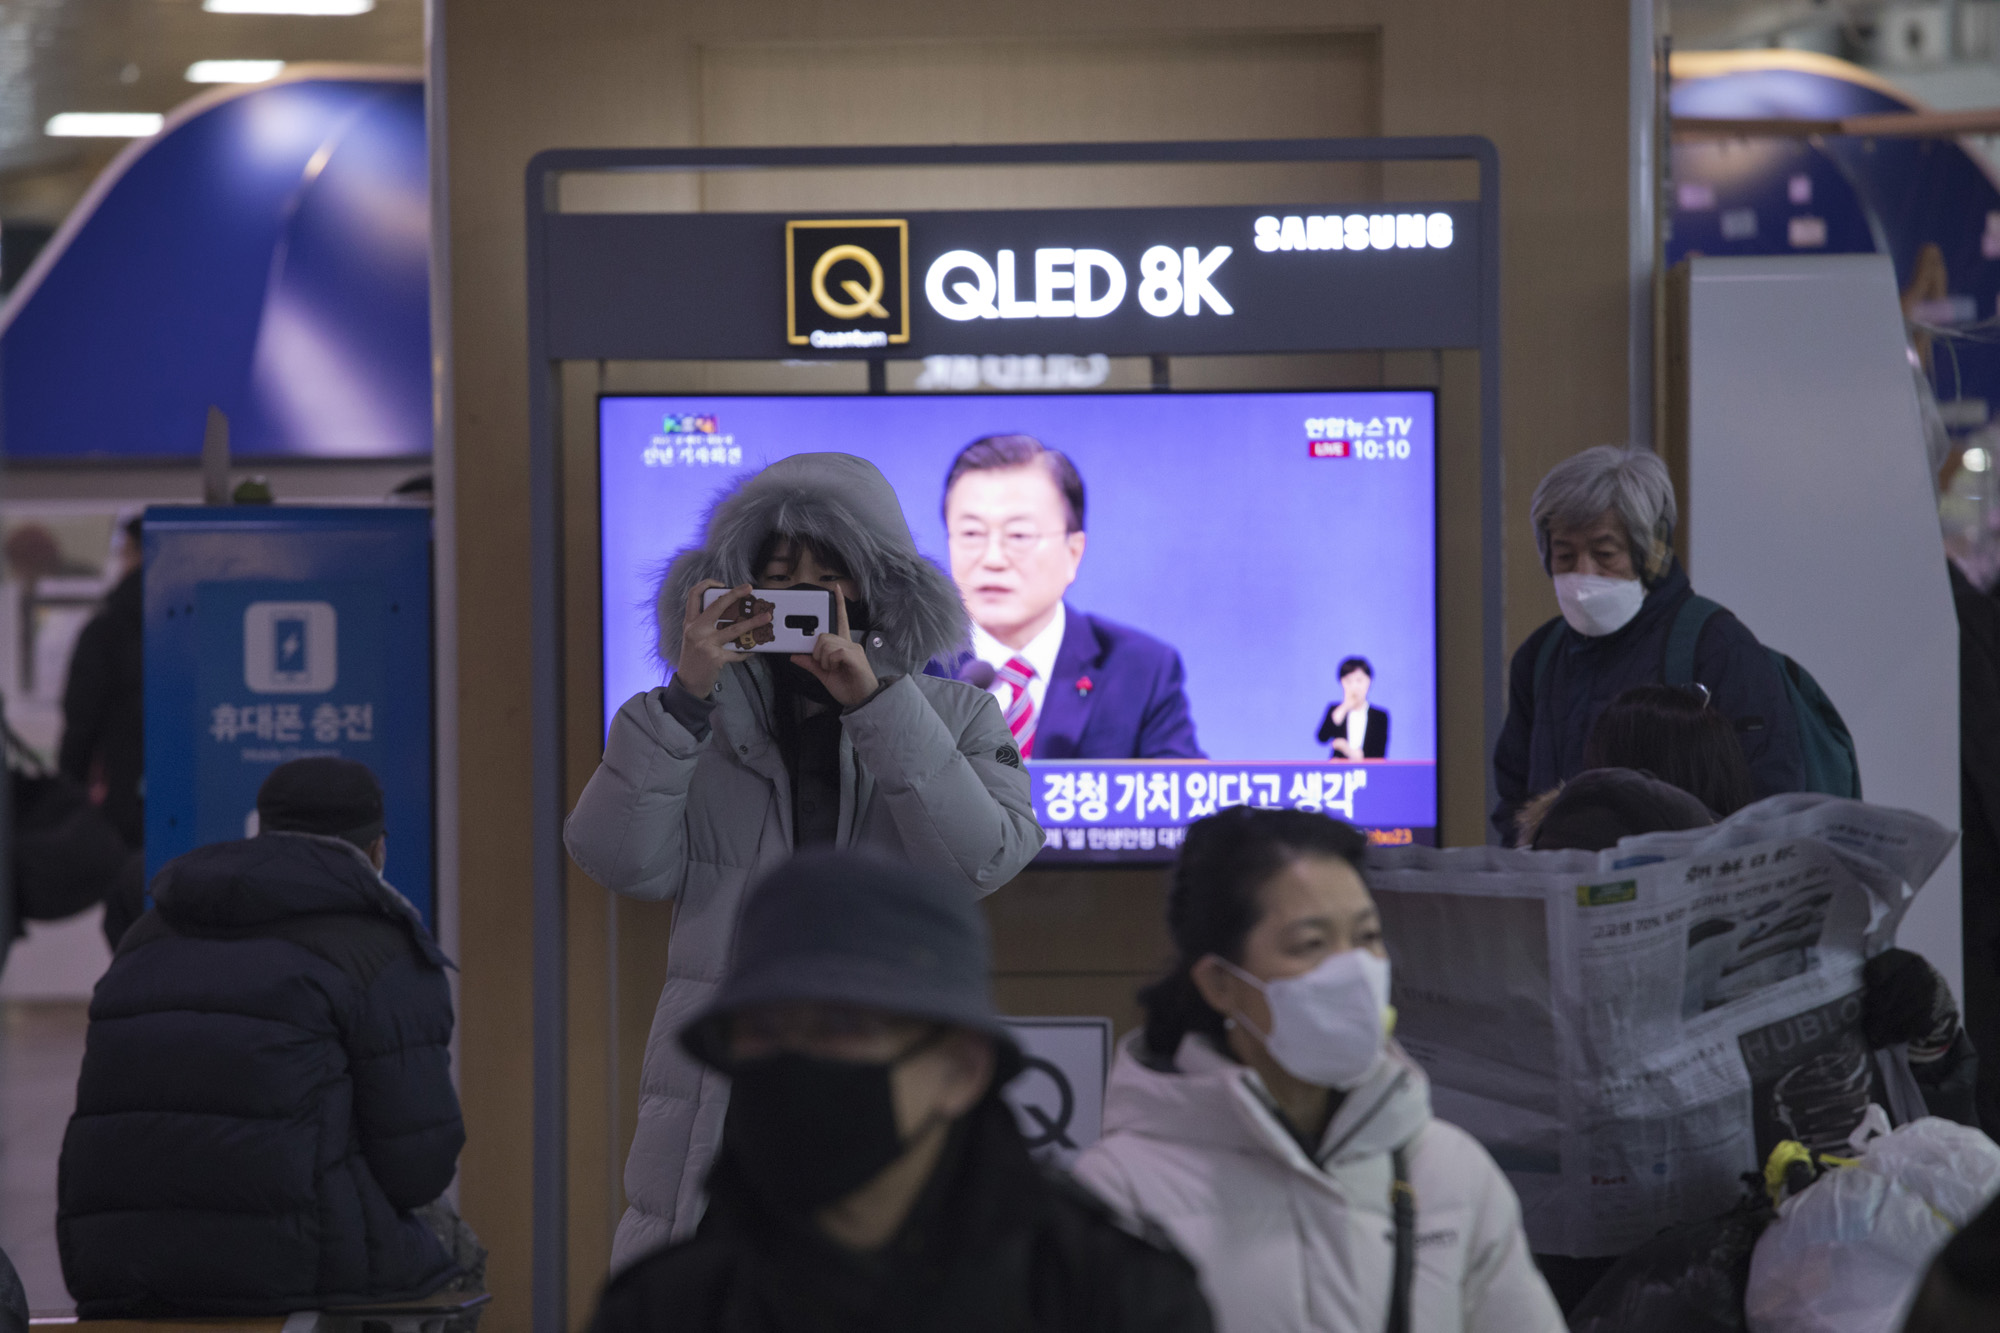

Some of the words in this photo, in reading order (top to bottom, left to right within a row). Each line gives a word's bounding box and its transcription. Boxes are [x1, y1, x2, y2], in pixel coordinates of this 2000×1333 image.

[1254, 212, 1454, 252] SAMSUNG
[811, 244, 889, 319] Q
[925, 247, 1127, 321] QLED
[1138, 244, 1235, 318] 8K
[1354, 439, 1411, 459] 10:10
[211, 703, 304, 742] 휴대폰
[311, 702, 374, 742] 충전
[1043, 772, 1109, 822] 경청
[1115, 771, 1182, 820] 가치
[1185, 771, 1284, 819] 있다고
[1741, 993, 1865, 1065] HUBLO
